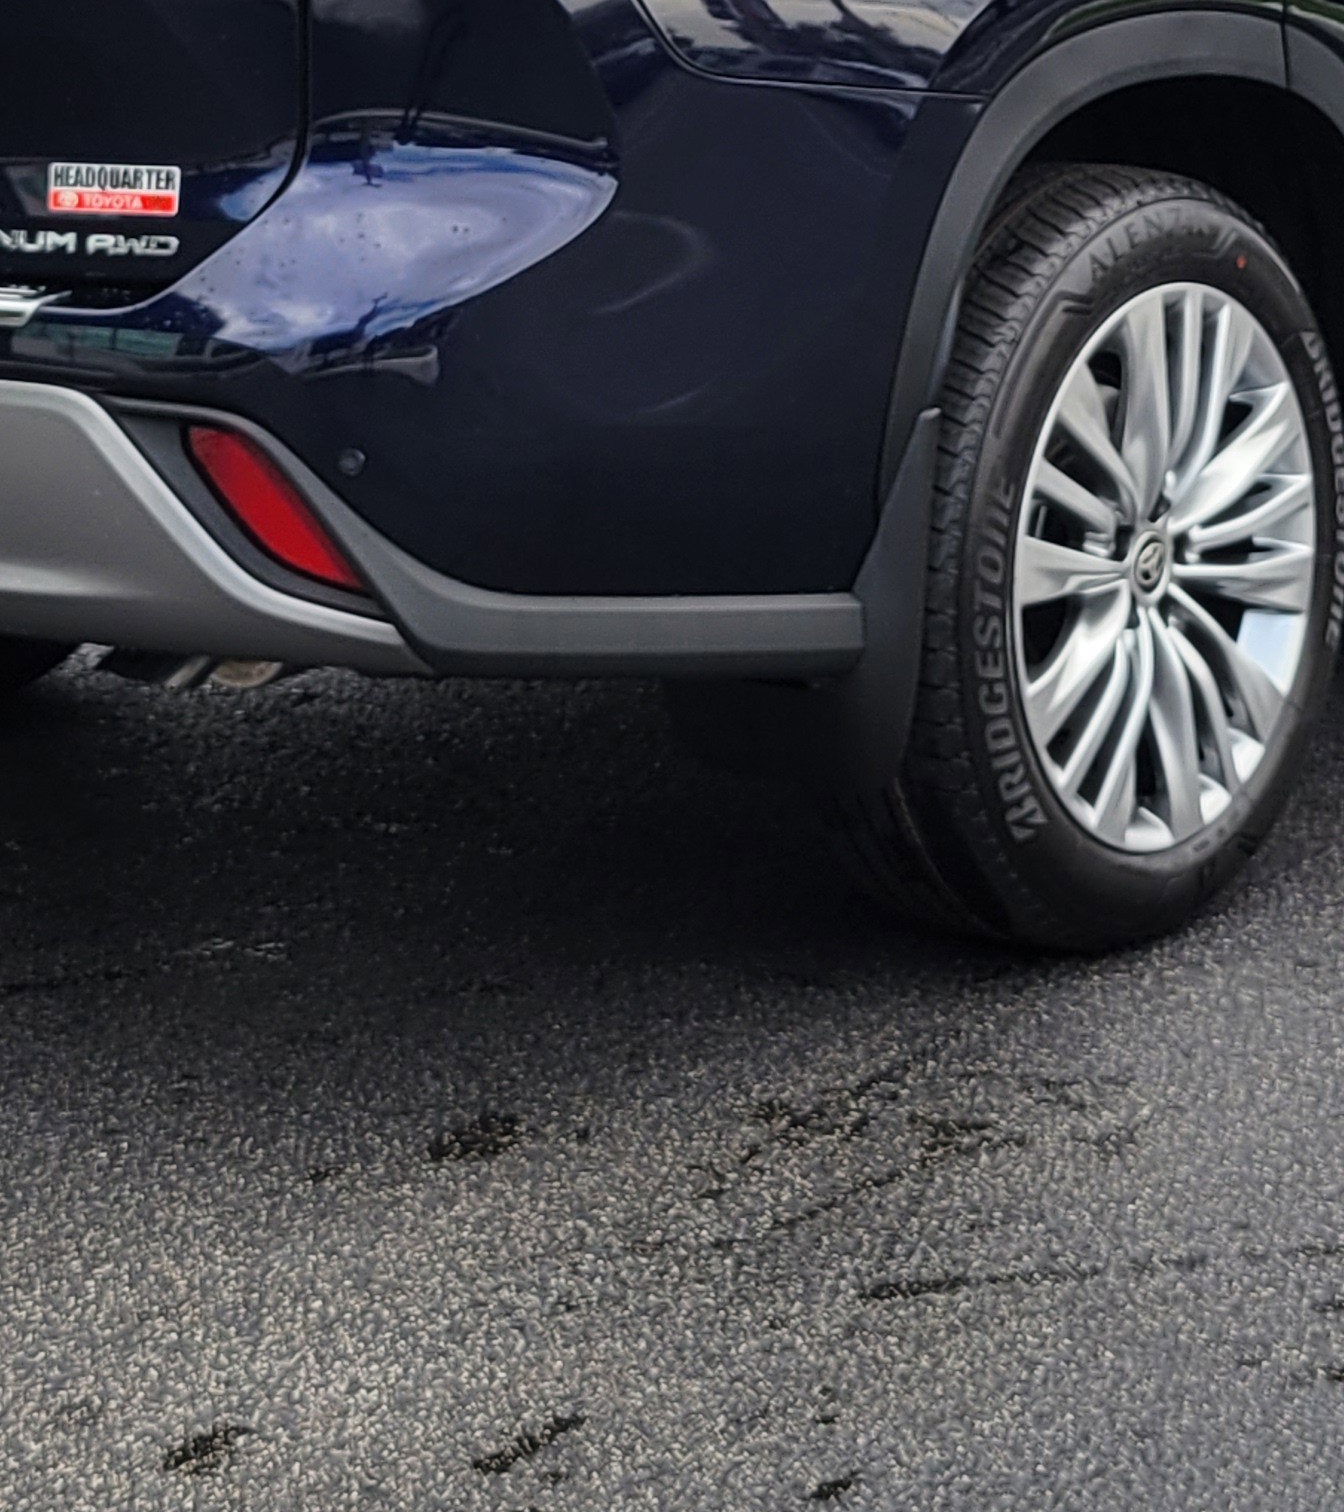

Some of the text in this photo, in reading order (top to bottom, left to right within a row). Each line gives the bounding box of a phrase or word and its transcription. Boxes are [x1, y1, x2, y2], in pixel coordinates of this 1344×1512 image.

[53, 165, 175, 191] HEADQUARTER
[82, 192, 143, 210] TOYOTA
[973, 476, 1048, 841] BRIDGESTONE
